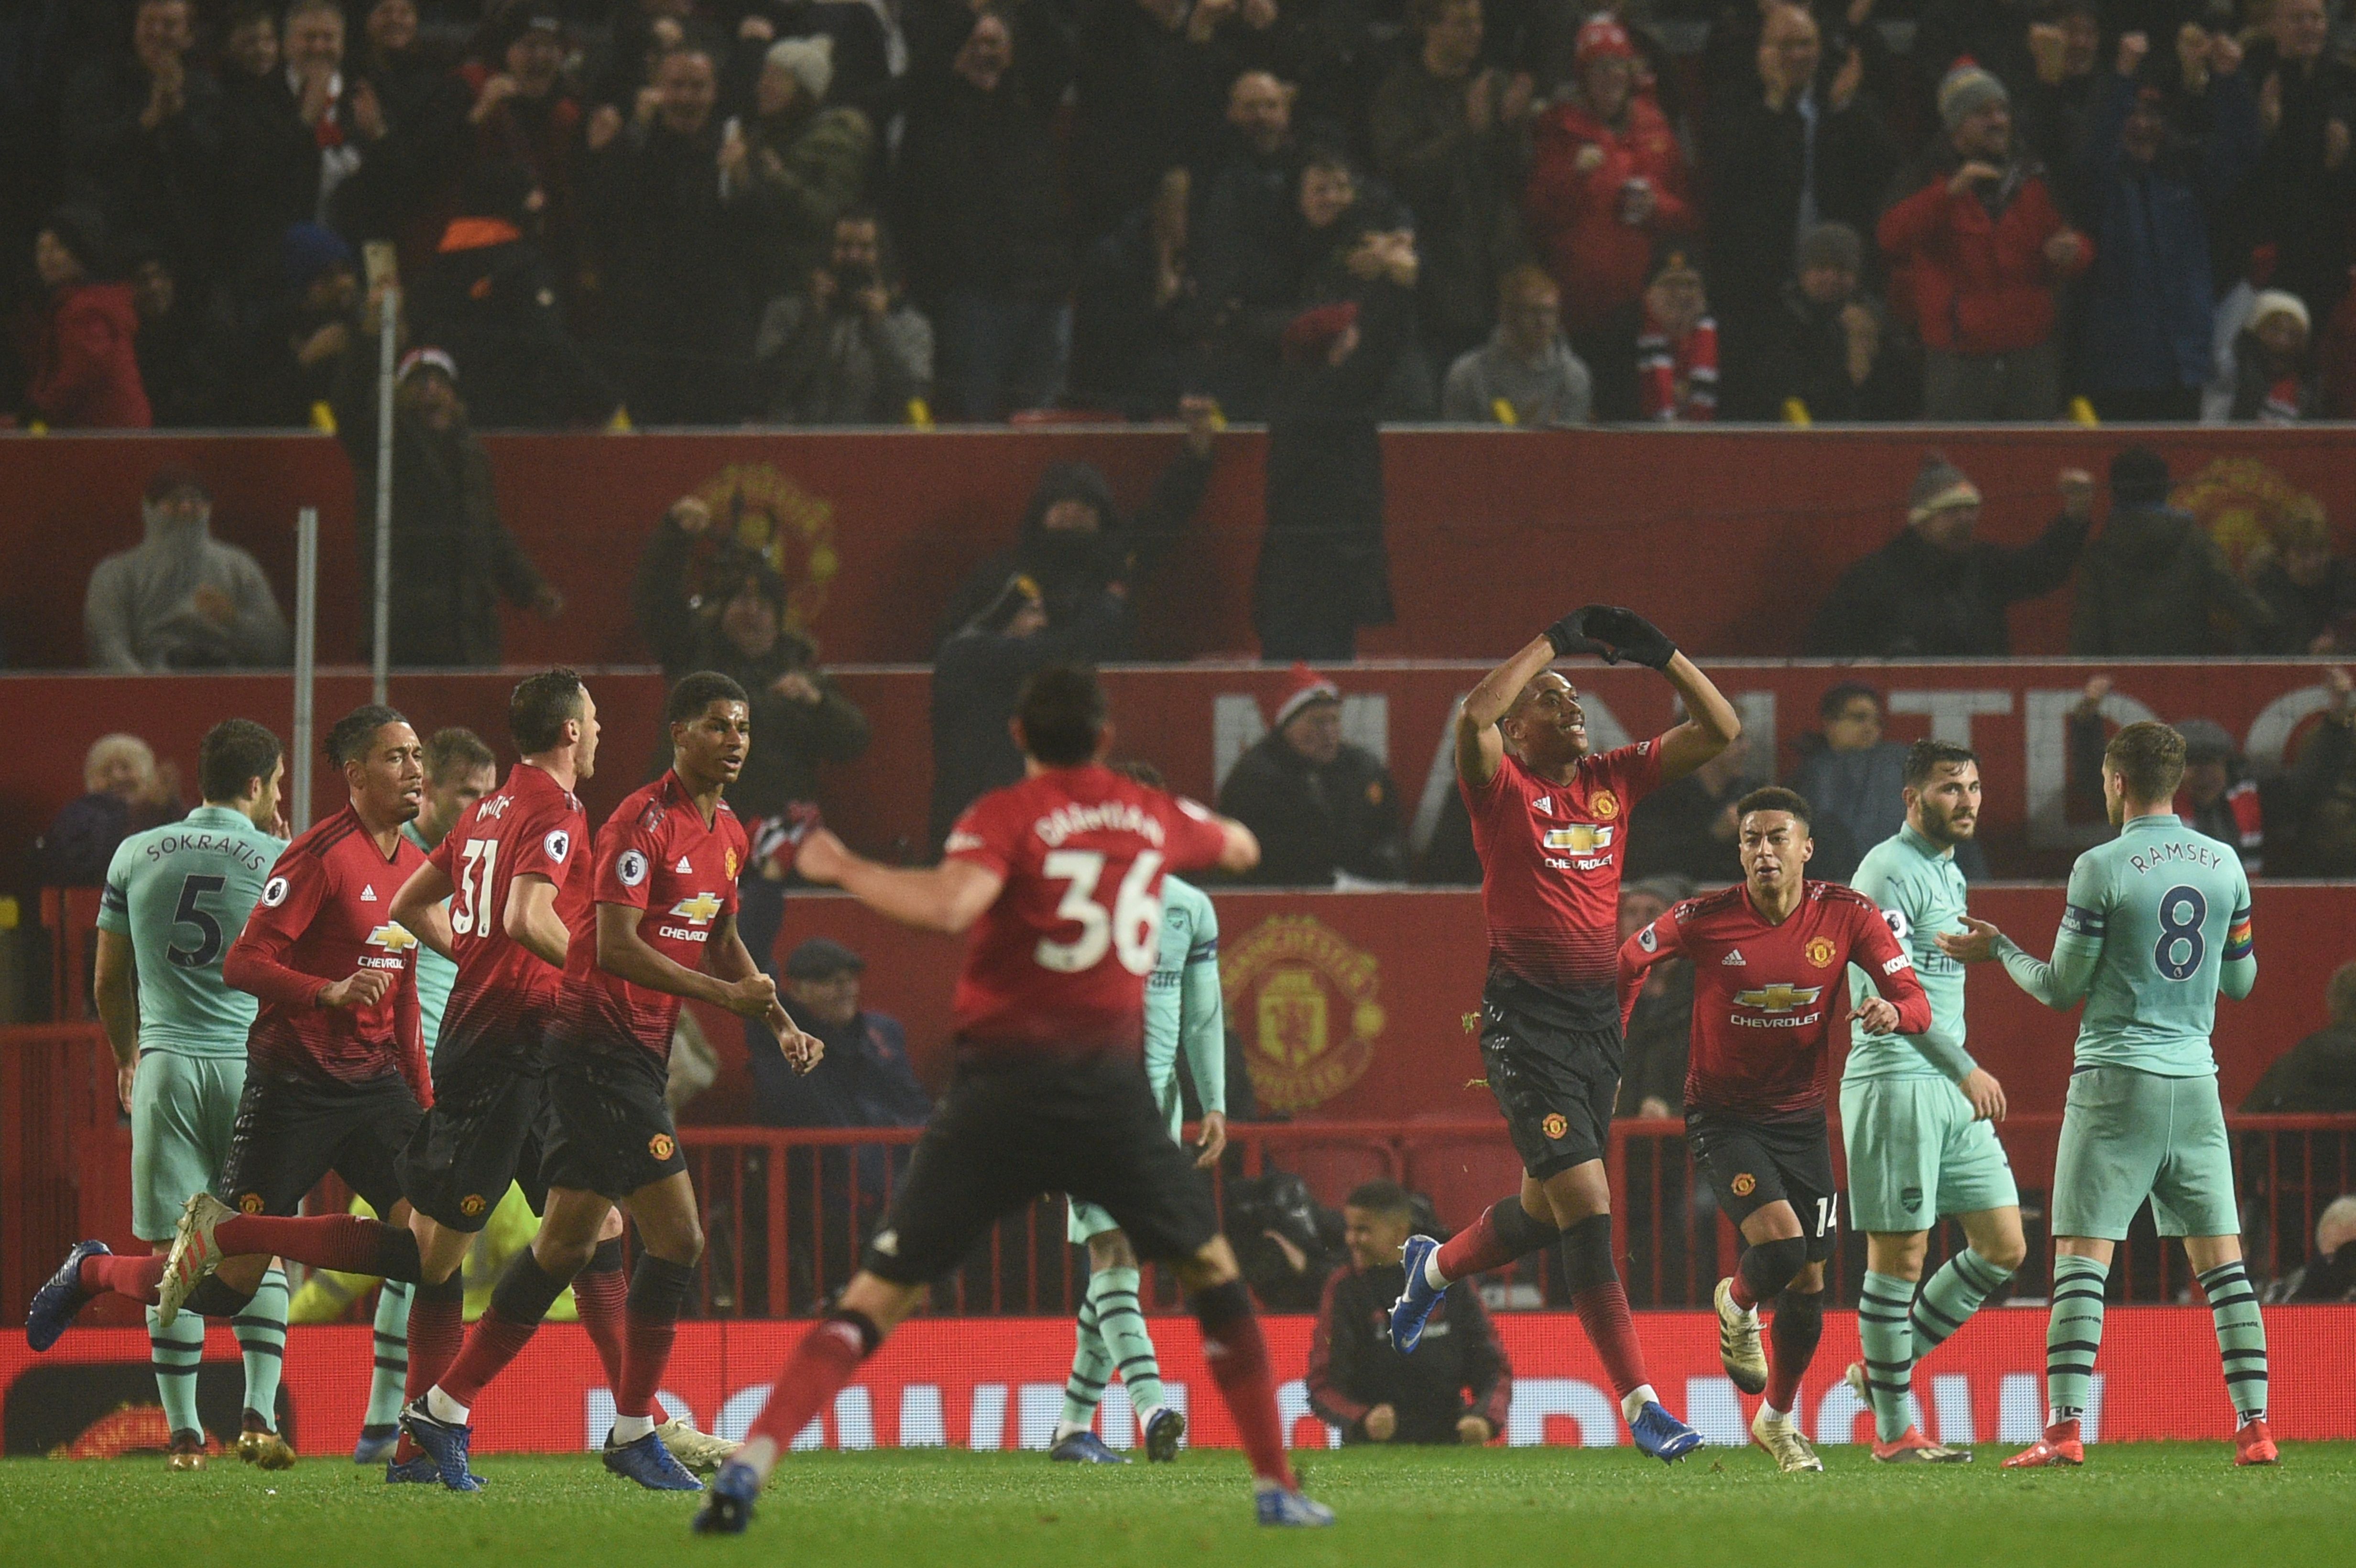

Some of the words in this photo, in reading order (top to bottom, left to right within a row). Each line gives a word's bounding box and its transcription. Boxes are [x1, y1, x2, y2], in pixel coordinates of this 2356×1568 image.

[147, 834, 266, 872] SOKRATIS
[1545, 854, 1613, 870] CHEVROLET
[2130, 842, 2223, 874] RAMSEY
[452, 838, 499, 938] 31
[165, 874, 227, 969] 5
[1034, 849, 1164, 976] 36
[2153, 884, 2208, 981] 8
[1731, 1012, 1821, 1027] CHEVROLET
[1816, 1191, 1837, 1238] 14
